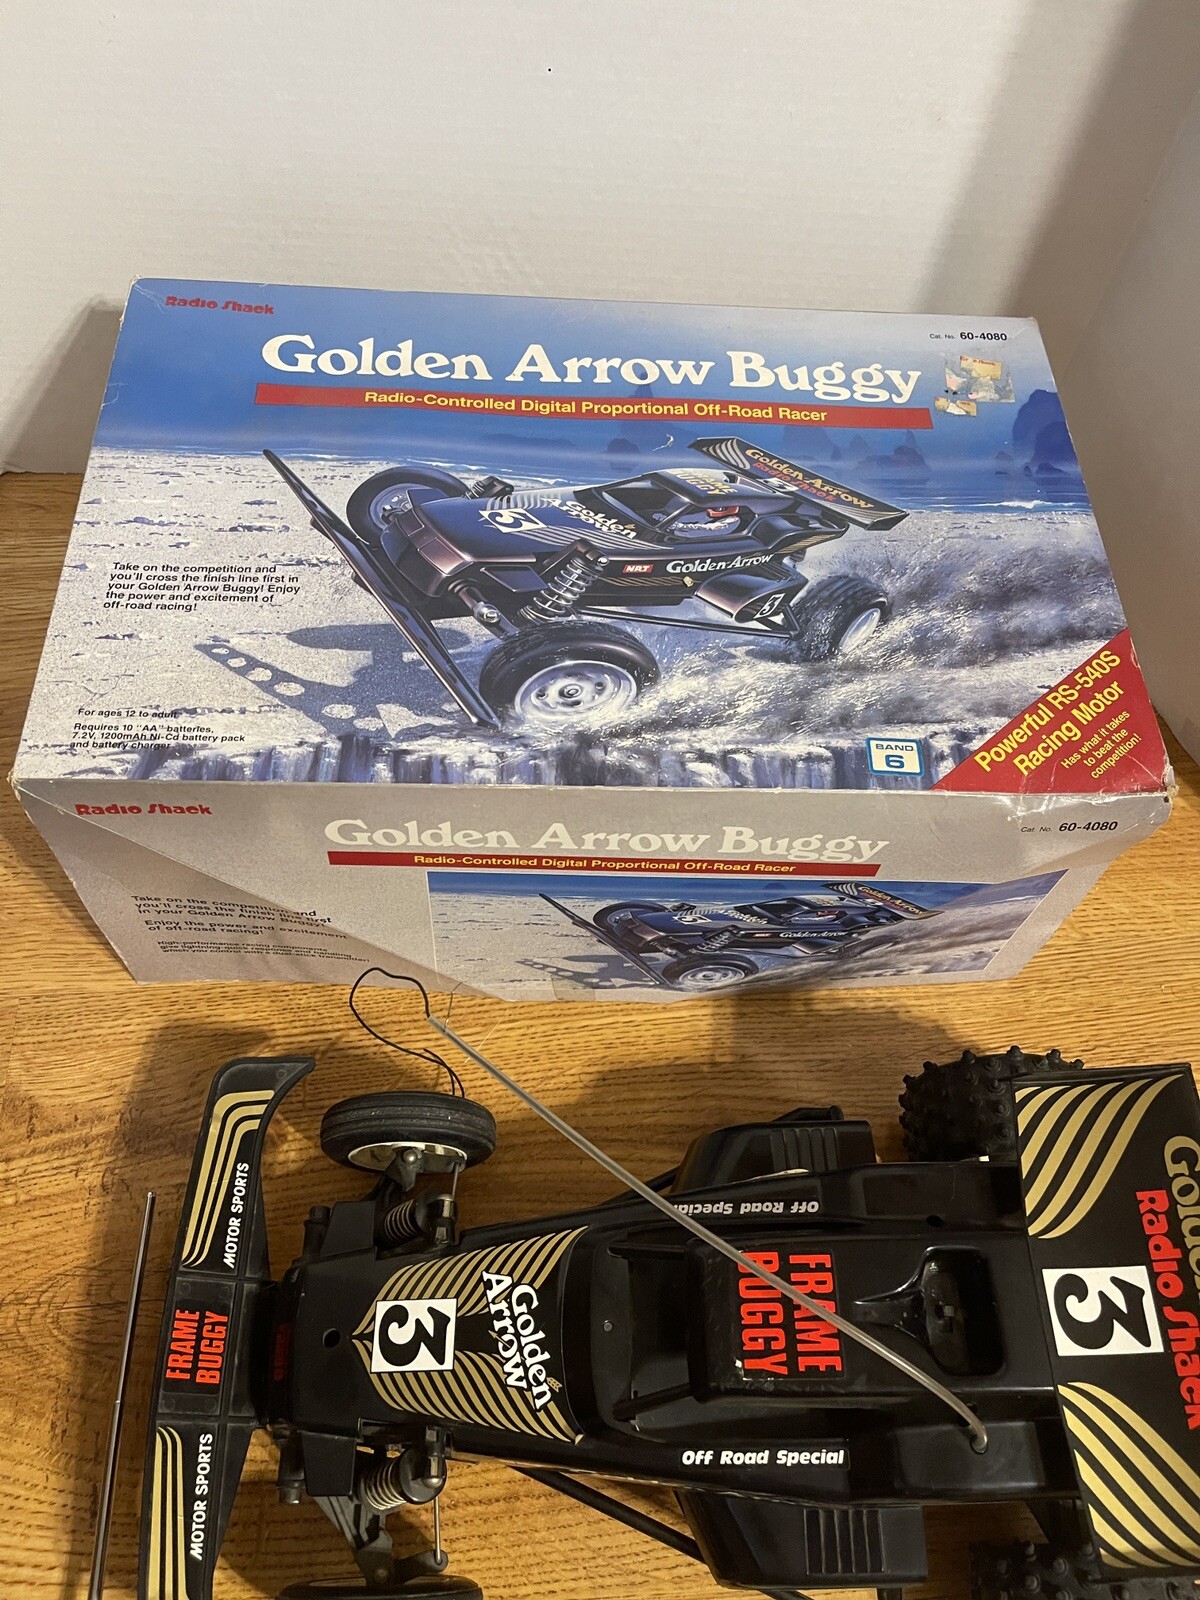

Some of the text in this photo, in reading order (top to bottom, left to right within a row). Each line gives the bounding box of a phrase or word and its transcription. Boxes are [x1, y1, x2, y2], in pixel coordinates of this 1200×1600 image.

[165, 296, 275, 315] Radio Shack
[960, 332, 1008, 341] 60-4080
[261, 334, 921, 404] Golden Arrow Buggy
[364, 391, 828, 422] Radio-Controlled Digital Proportional Off-Road Racer
[745, 449, 875, 508] Golden Arrow
[565, 500, 637, 539] Golden
[112, 562, 277, 575] Take on the competition and
[625, 564, 650, 572] NRT
[666, 553, 775, 573] Golden Arrow
[109, 572, 299, 584] you'll cross the finish line first in
[105, 591, 275, 603] the power and excitement of
[108, 583, 301, 595] your Golden Arrow Buggy! Enjoy
[103, 601, 198, 613] off-road racing!
[77, 708, 96, 716] For
[97, 710, 122, 718] ages
[126, 710, 136, 718] 12
[151, 710, 178, 719] adult
[973, 649, 1122, 773] Powerful RS-540S
[74, 722, 120, 732] Requires
[122, 724, 133, 732] 10
[166, 725, 214, 734] batteries,
[1012, 680, 1125, 777] Racing Motor
[69, 740, 172, 750] and battery charger
[72, 732, 246, 744] 7.2V, 1200mAh Ni-Cd battery pack
[875, 743, 914, 752] BAND
[1060, 710, 1130, 769] Has what it takes
[1082, 728, 1128, 767] to beat the
[884, 754, 905, 769] 6
[1090, 732, 1142, 779] competition!
[74, 804, 214, 816] Radio Shack
[1058, 820, 1119, 832] 60-4080
[324, 818, 890, 862] Golden Arrow Buggy
[413, 855, 797, 873] Radio-Controlled Digital Proportional Off-Road Racer
[131, 895, 163, 903] Take
[212, 900, 289, 914] competition
[187, 909, 234, 918] Golden
[238, 913, 276, 922] Arrow
[280, 918, 326, 928] Buggy!
[239, 908, 275, 917] finish
[279, 912, 300, 920] line
[305, 916, 332, 924] first
[184, 920, 206, 928] the
[208, 922, 248, 930] power
[279, 926, 348, 939] excitement
[220, 928, 264, 936] racing!
[222, 1162, 250, 1269] MOTOR SPORTS
[739, 1201, 785, 1215] Road
[790, 1200, 820, 1214] Off
[1164, 1135, 1200, 1303] Gold
[1135, 1189, 1184, 1299] Radio
[737, 1251, 788, 1376] BUGGY
[789, 1253, 843, 1373] FRAME
[1053, 1273, 1152, 1350] 3
[378, 1304, 452, 1367] 3
[482, 1270, 527, 1390] Arrow
[165, 1309, 200, 1380] FRAME
[195, 1310, 229, 1385] BUGGY
[511, 1283, 554, 1411] Golden
[681, 1448, 845, 1467] Off Road Special
[189, 1432, 214, 1561] MOTOR SPORTS
